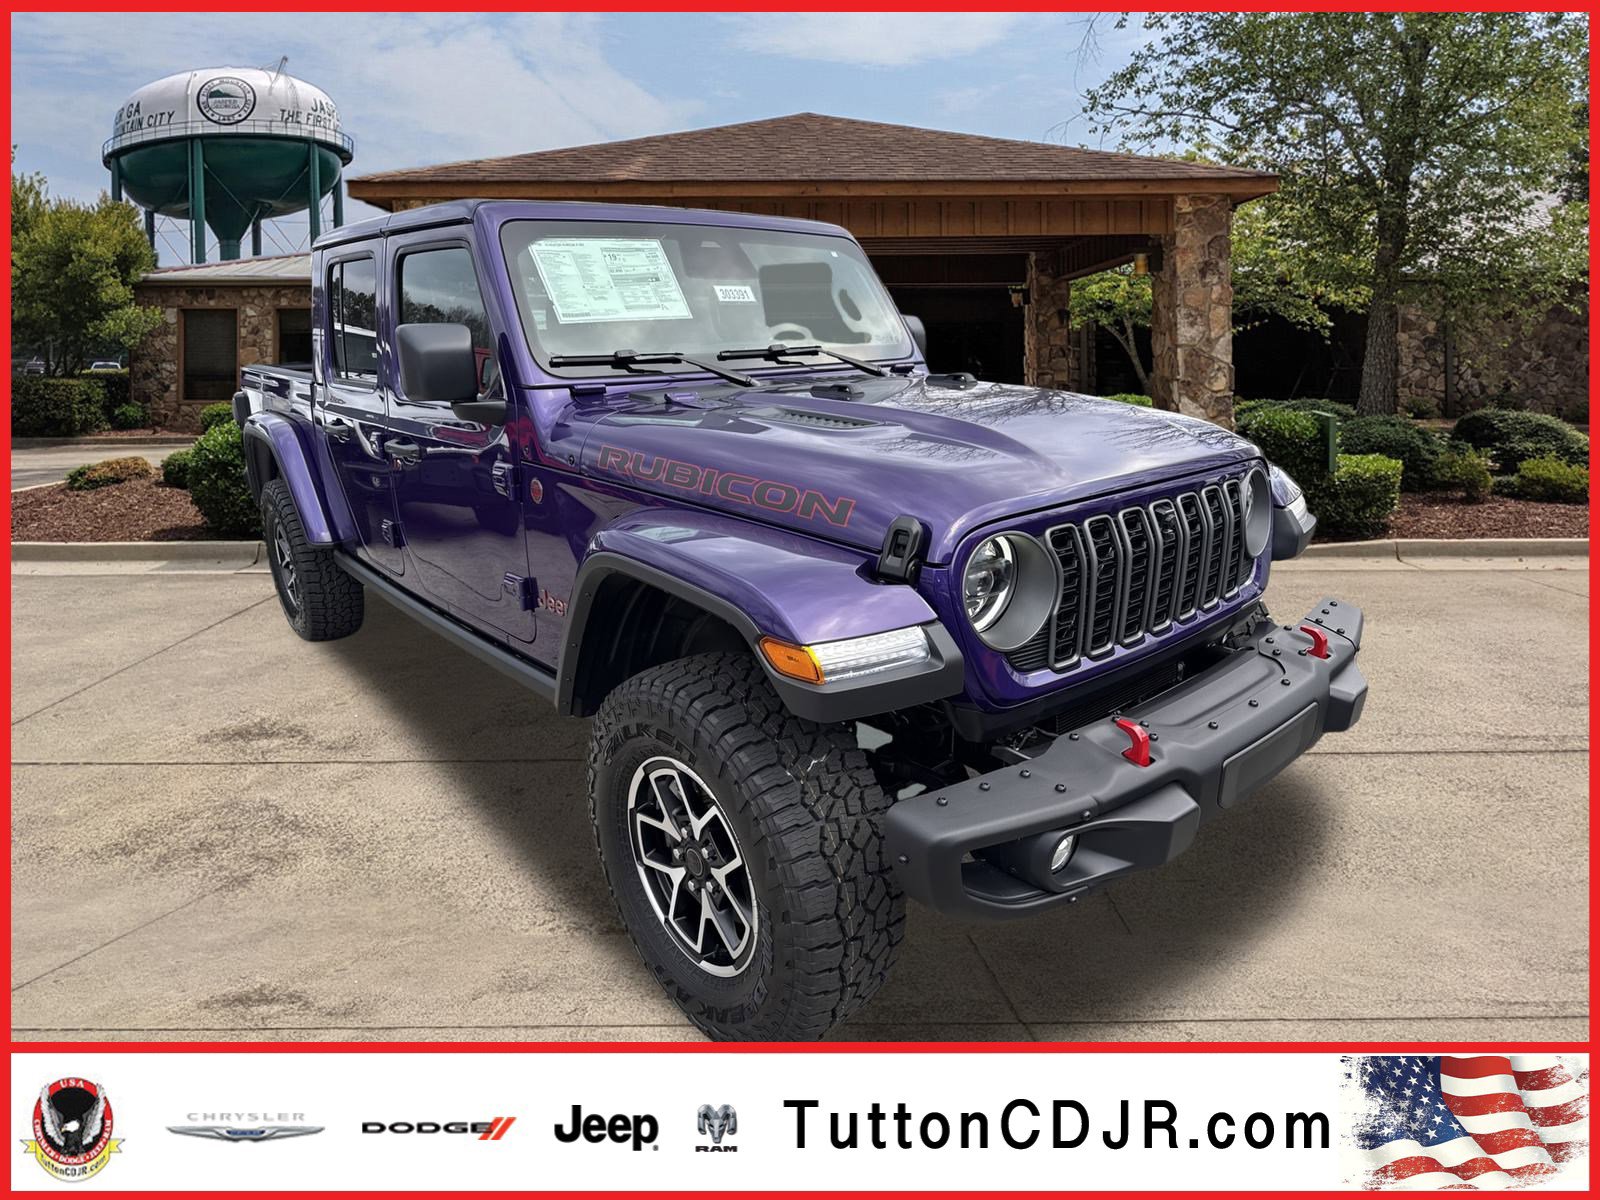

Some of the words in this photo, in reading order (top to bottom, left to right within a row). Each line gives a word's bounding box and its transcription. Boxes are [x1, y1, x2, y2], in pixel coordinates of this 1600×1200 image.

[127, 101, 141, 118] GA
[147, 110, 175, 127] CITY
[280, 109, 302, 124] THE
[306, 112, 331, 129] FIRST
[719, 288, 751, 300] 303391
[598, 445, 856, 528] RUBICON
